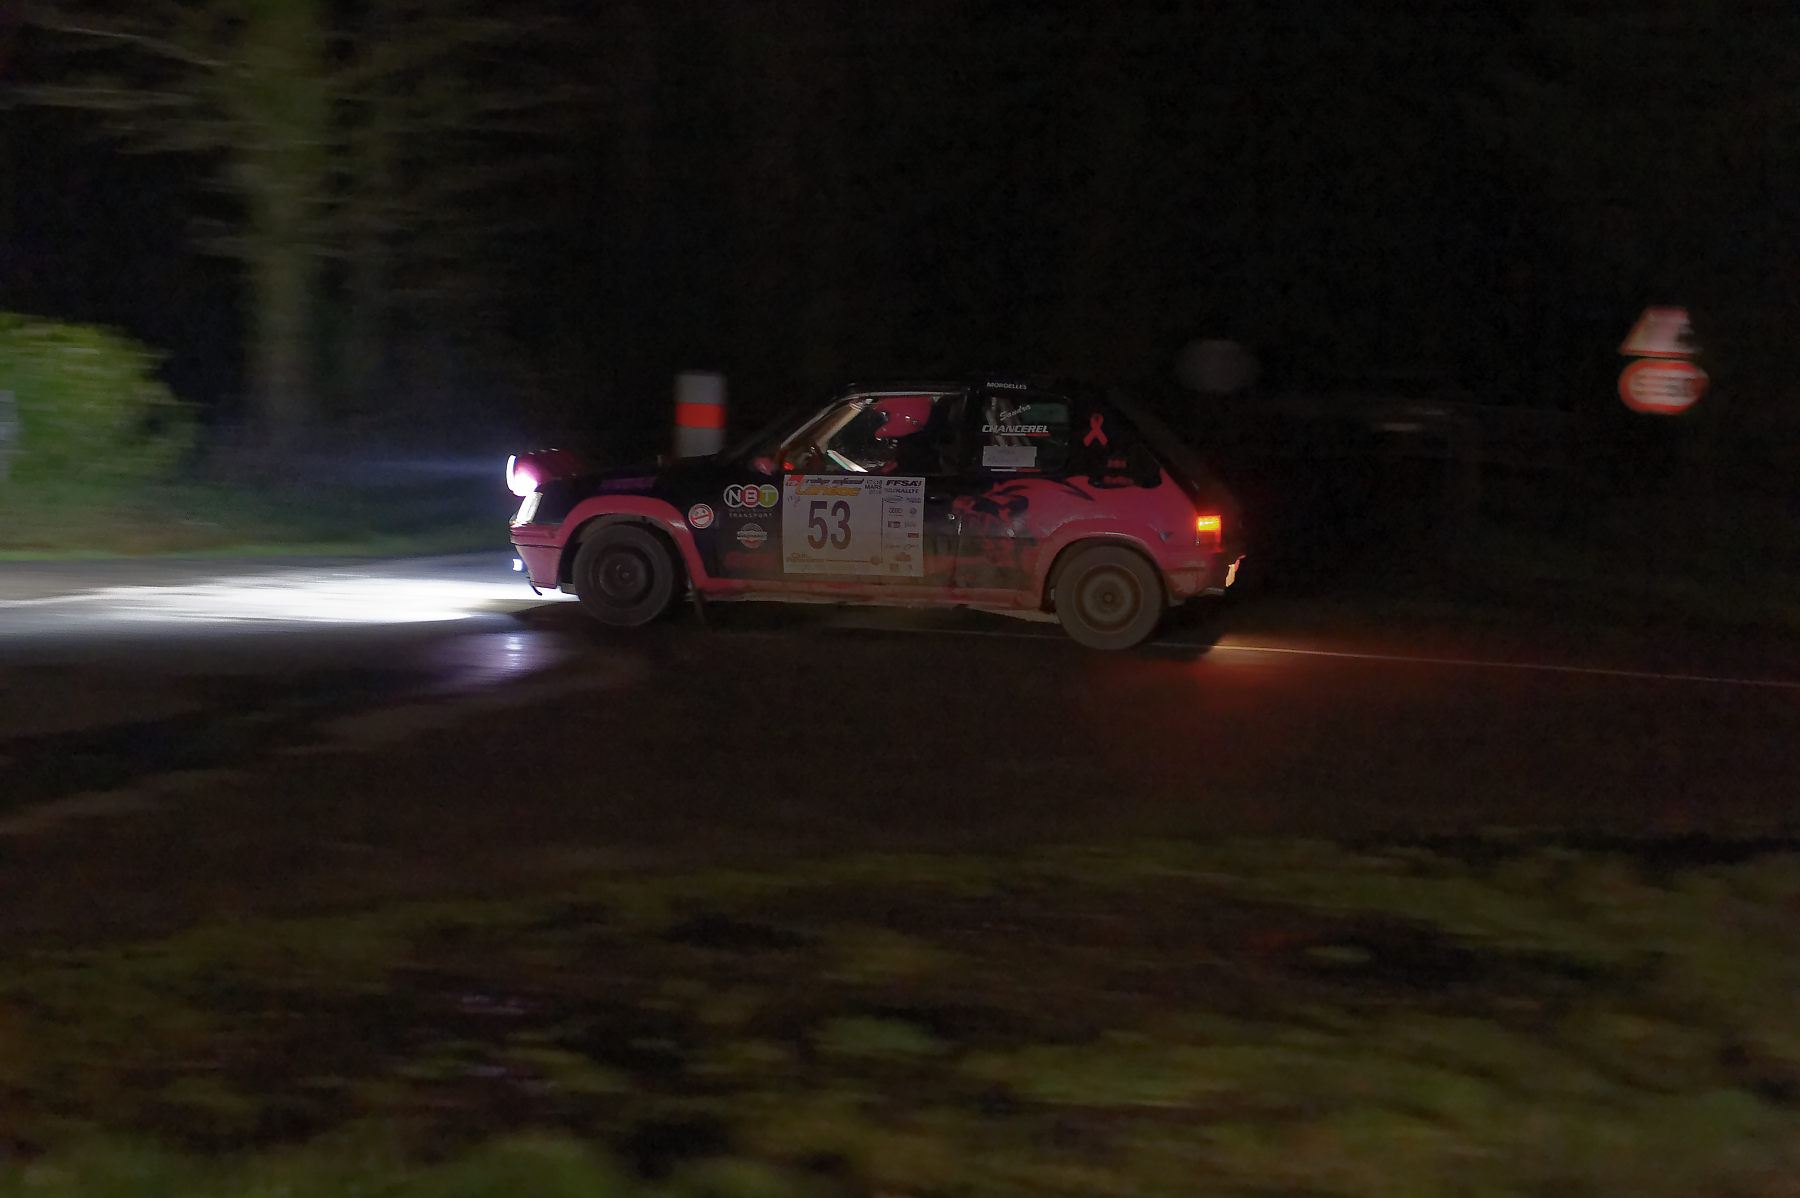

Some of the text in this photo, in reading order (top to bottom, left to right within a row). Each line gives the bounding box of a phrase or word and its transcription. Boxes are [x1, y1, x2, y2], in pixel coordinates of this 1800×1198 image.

[986, 382, 1027, 390] MORDELLES
[981, 424, 1050, 433] CHANCEREL
[726, 487, 778, 506] NBT
[807, 500, 851, 550] 53
